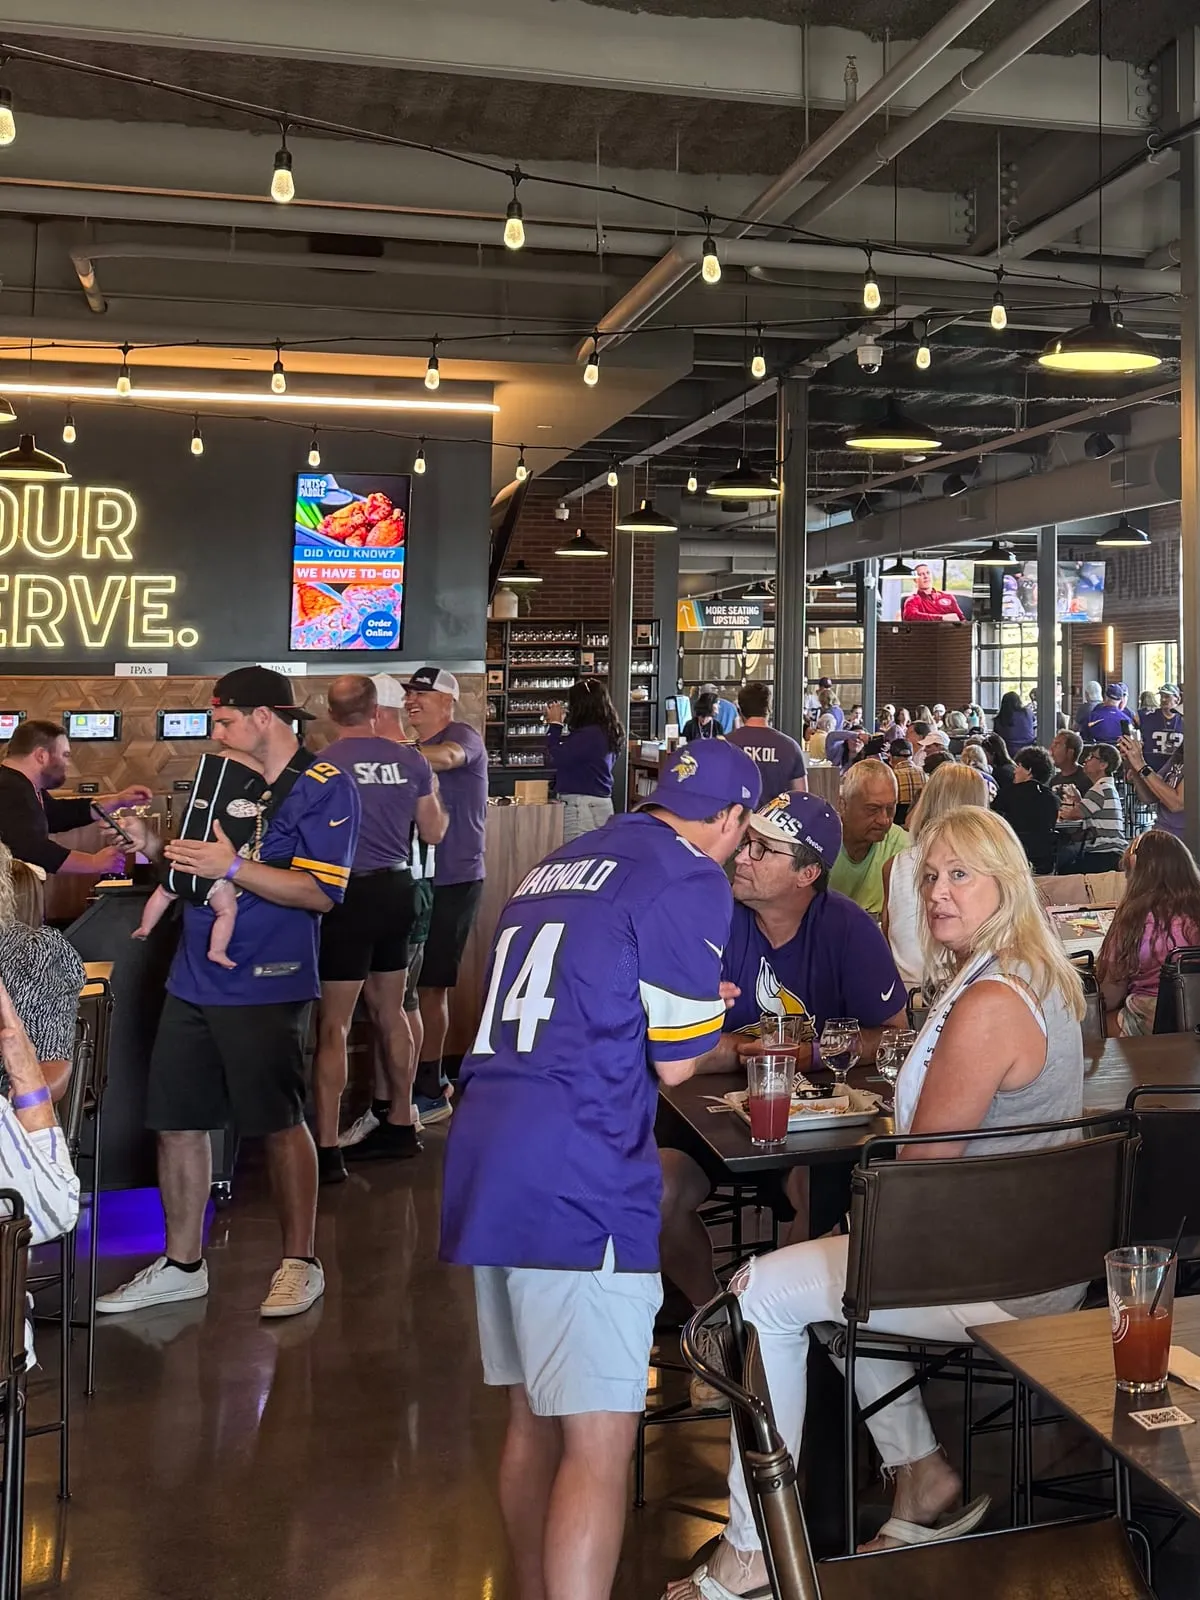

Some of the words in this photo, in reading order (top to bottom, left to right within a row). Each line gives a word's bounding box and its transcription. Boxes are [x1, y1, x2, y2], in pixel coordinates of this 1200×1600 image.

[303, 548, 324, 558] DID
[327, 549, 350, 558] YOU
[353, 550, 396, 559] KNOW?
[296, 568, 318, 578] WE
[321, 568, 357, 578] HAVE
[360, 569, 400, 579] TO-GO
[0, 574, 199, 648] RVE.
[705, 606, 727, 615] MORE
[728, 606, 760, 616] SEATING
[367, 619, 392, 628] Order
[712, 615, 750, 625] UPSTAIRS
[365, 629, 393, 638] Online
[743, 746, 780, 763] SKOL
[304, 762, 342, 784] 19
[353, 762, 409, 785] SKOL
[512, 858, 618, 898] DARNOLD
[471, 922, 566, 1055] 14
